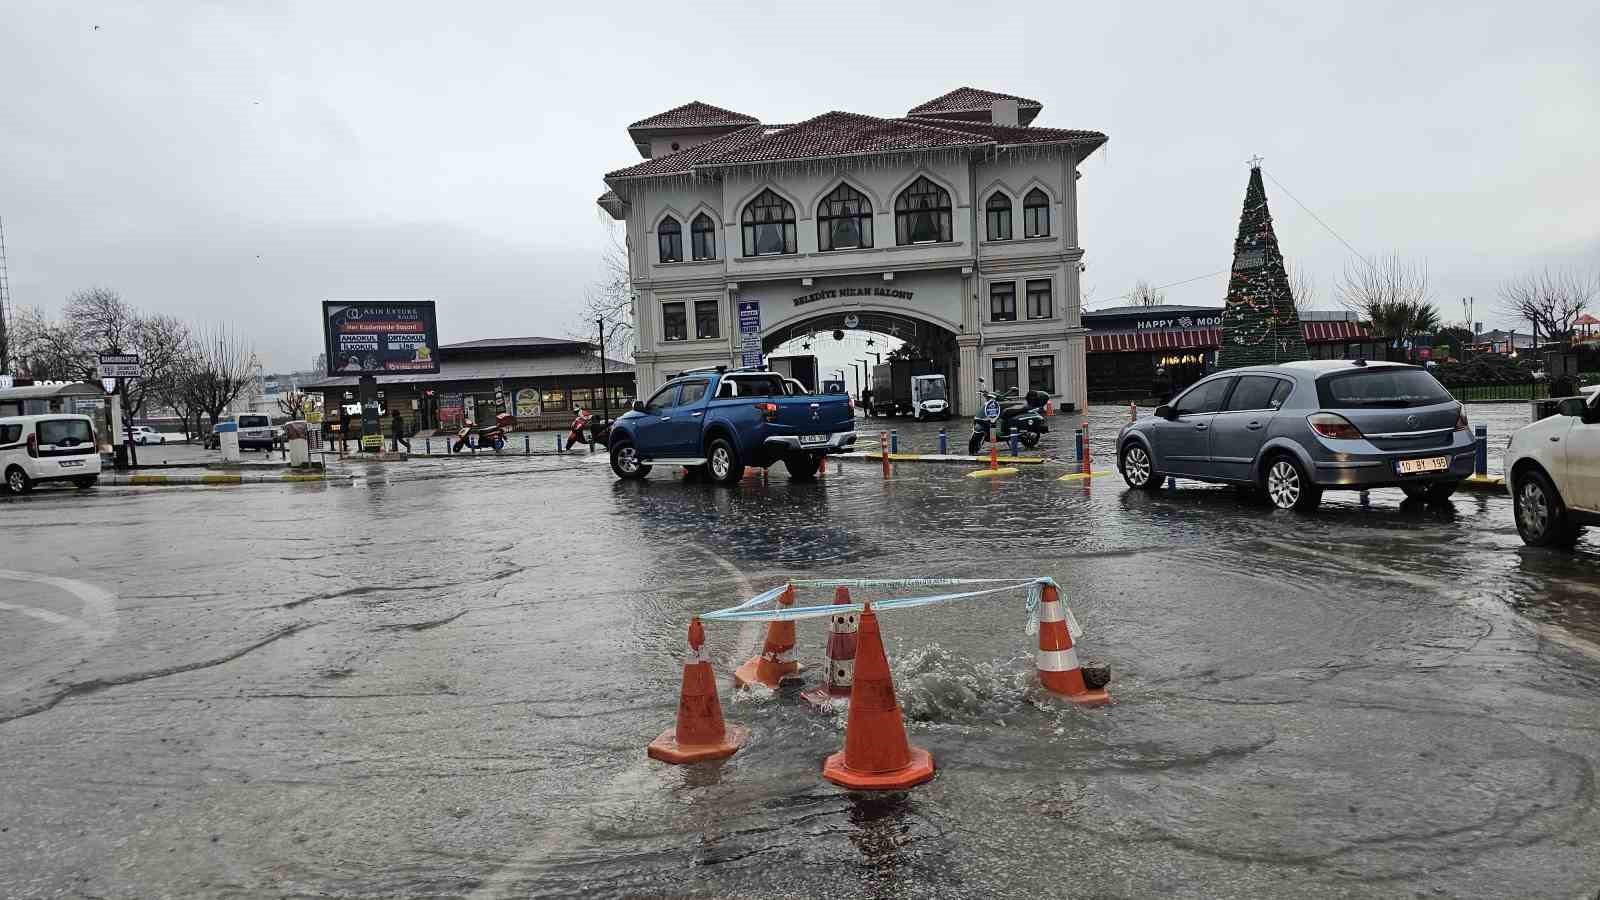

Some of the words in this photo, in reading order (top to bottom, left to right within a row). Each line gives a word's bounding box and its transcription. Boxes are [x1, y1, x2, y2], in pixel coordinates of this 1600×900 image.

[792, 289, 836, 306] BELEDİYE
[839, 287, 871, 297] NİKAH
[874, 287, 914, 301] SALONU
[1137, 319, 1174, 329] HAPPY
[1197, 316, 1223, 327] MOO
